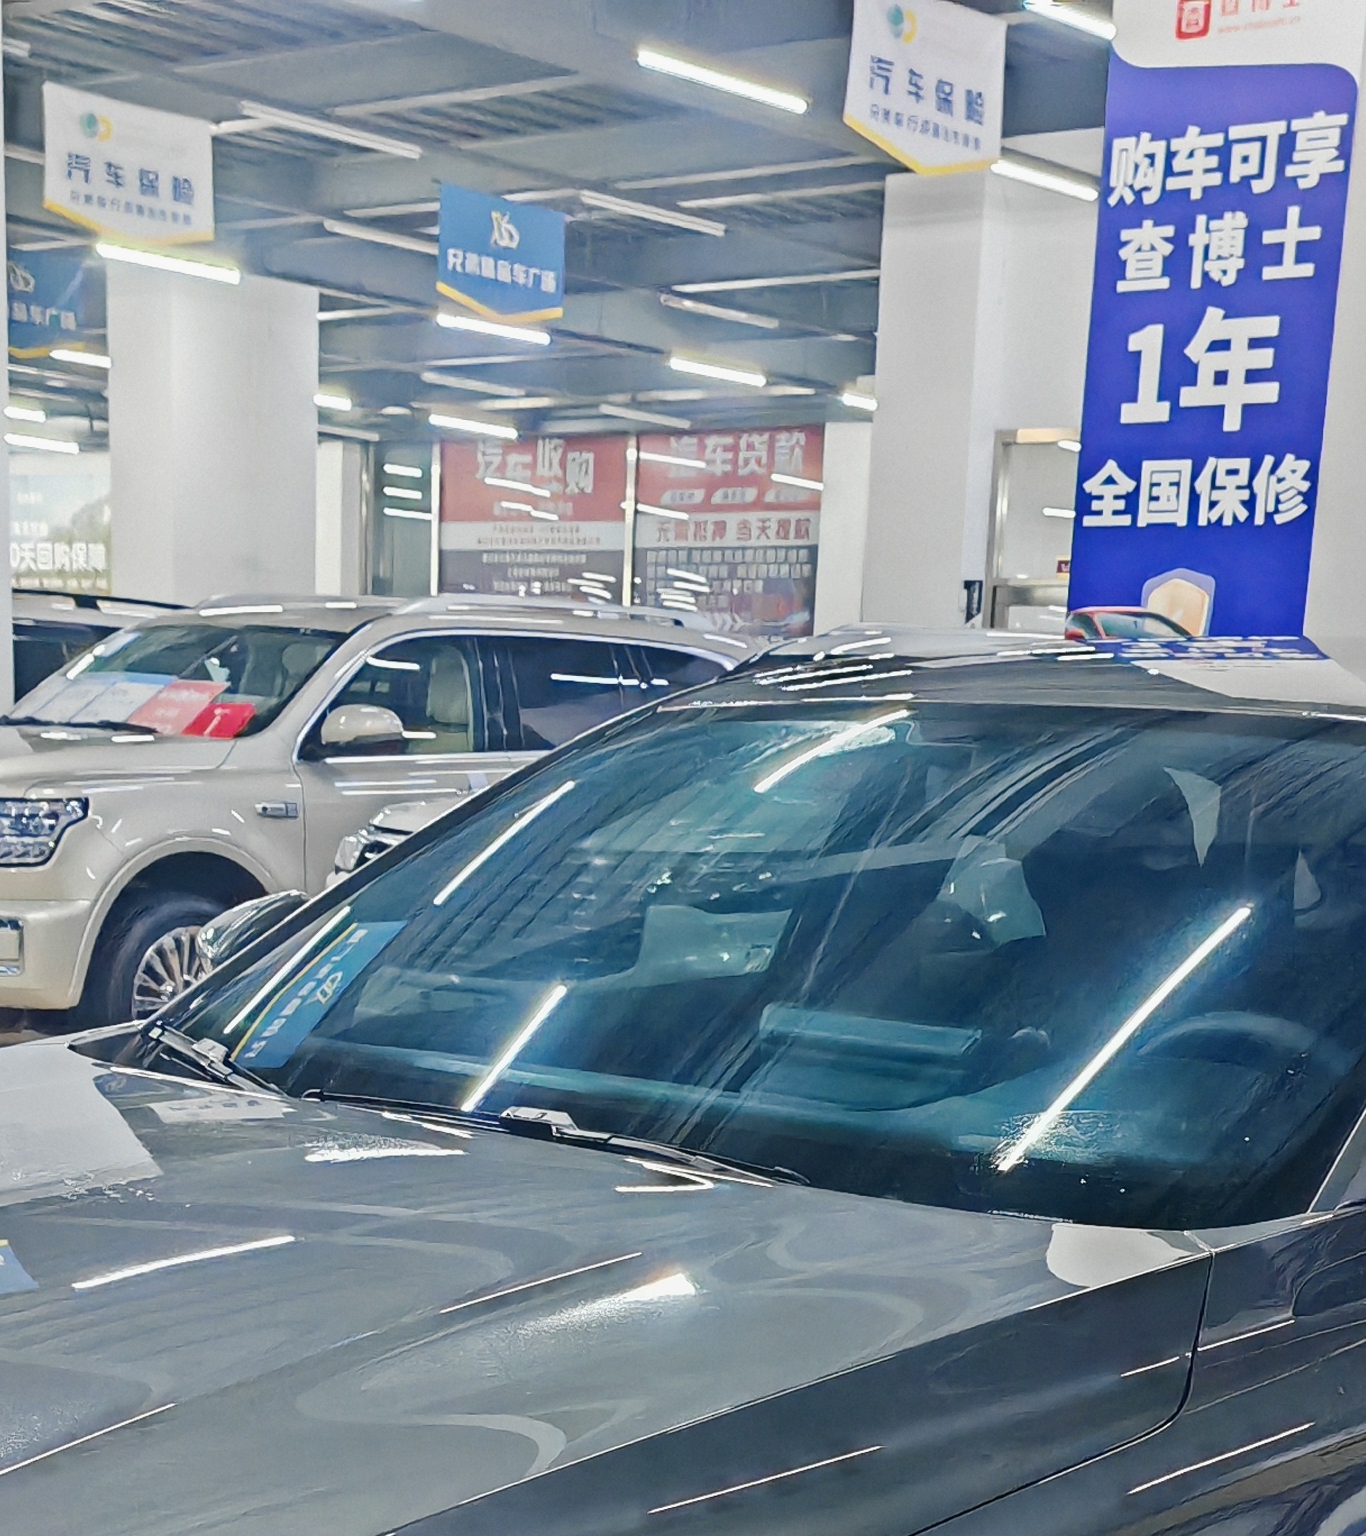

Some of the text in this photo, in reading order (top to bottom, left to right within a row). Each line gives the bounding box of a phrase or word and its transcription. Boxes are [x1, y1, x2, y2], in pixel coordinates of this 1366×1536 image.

[1107, 110, 1349, 207] 购车可享
[1116, 206, 1322, 293] 查博士
[1120, 306, 1281, 432] 1年
[1082, 454, 1312, 527] 全国保修
